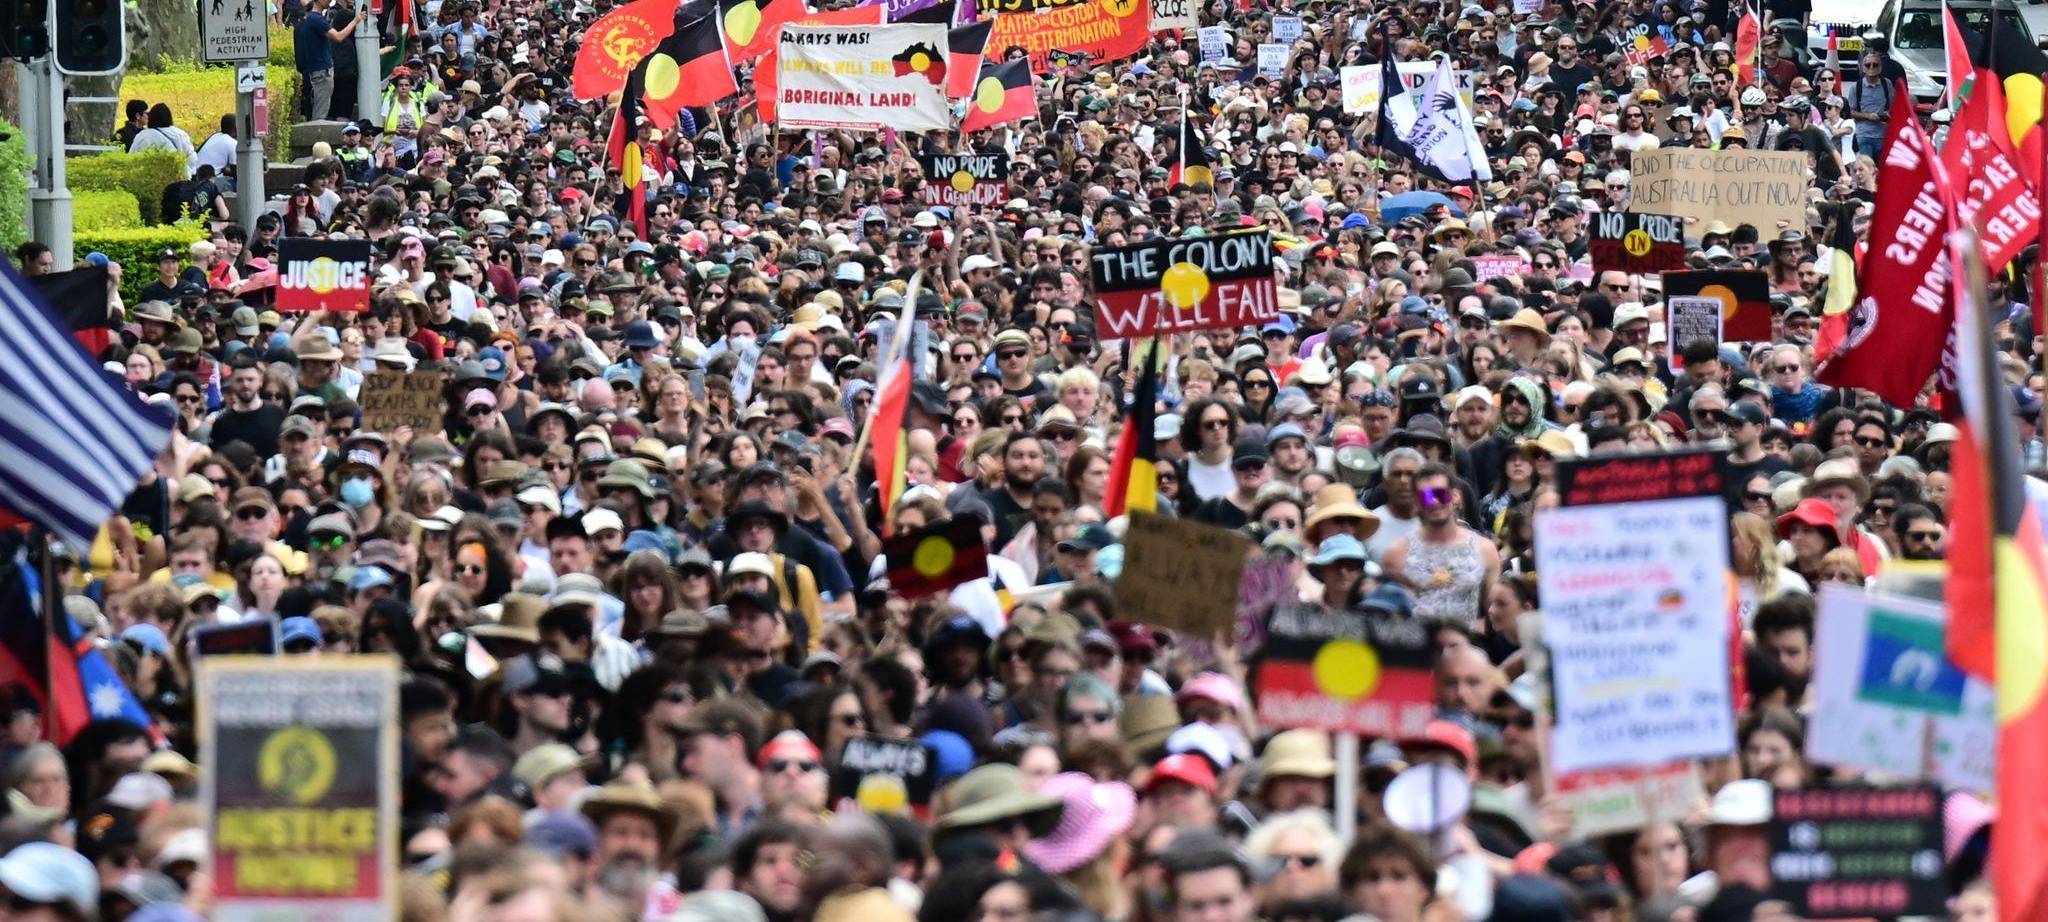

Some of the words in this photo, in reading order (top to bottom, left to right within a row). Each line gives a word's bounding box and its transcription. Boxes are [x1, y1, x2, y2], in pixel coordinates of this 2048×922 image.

[994, 14, 1039, 33] DEATHS
[1050, 2, 1100, 27] CUSTODY
[210, 35, 262, 45] PEDESTRIAN
[225, 26, 246, 34] HIGH
[836, 32, 870, 45] WAS!
[1615, 23, 1649, 46] LAND
[217, 45, 257, 54] ACTIVITY
[1626, 45, 1658, 67] LIFE
[783, 60, 830, 72] LWAYS
[835, 60, 864, 75] WILL
[782, 88, 864, 107] BORIGINAL
[869, 92, 917, 107] LAND!
[934, 156, 956, 178] NO
[960, 156, 998, 179] PRIDE
[1632, 156, 1660, 177] END
[1664, 153, 1695, 170] THE
[1700, 156, 1802, 177] OCCUPATION
[943, 183, 1006, 206] GENOCIDE
[1632, 178, 1719, 205] AUSTRALIA
[1726, 180, 1764, 207] OUT
[1767, 180, 1802, 206] NOW
[1599, 212, 1625, 240] NO
[1639, 213, 1681, 244] PRIDE
[1629, 234, 1646, 252] IN
[1092, 247, 1158, 283] THE
[1169, 233, 1272, 273] COLONY
[280, 260, 367, 289] JUSTICE
[1098, 287, 1210, 335] WILL
[1218, 279, 1280, 321] FALL
